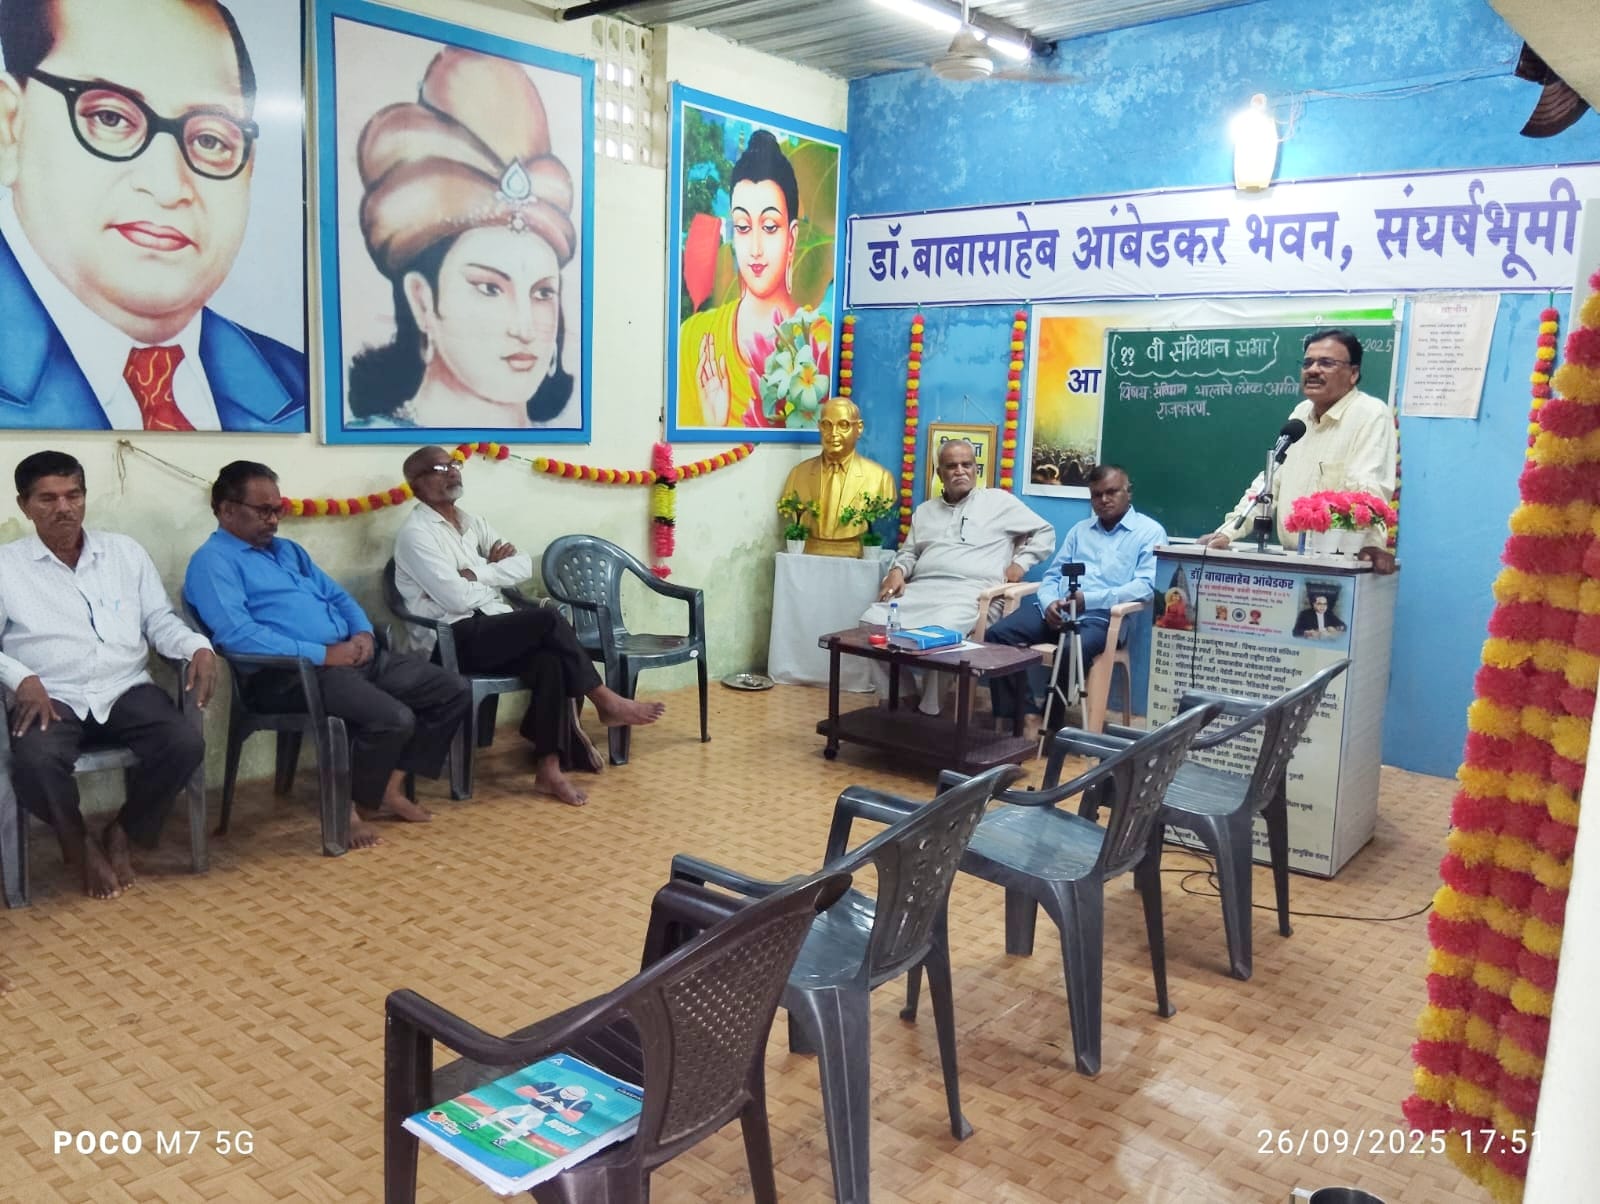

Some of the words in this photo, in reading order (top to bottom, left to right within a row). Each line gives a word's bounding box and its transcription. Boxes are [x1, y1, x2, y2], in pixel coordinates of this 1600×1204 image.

[1072, 202, 1231, 270] आंबेडकर
[1246, 210, 1353, 272] भवन,
[1374, 177, 1583, 282] संघर्षभूमी
[1147, 336, 1166, 363] वी
[1169, 333, 1230, 363] संविधान
[1235, 337, 1271, 358] सभा
[1205, 571, 1250, 585] बाबासाहेब
[1253, 574, 1294, 589] आंबेडकर
